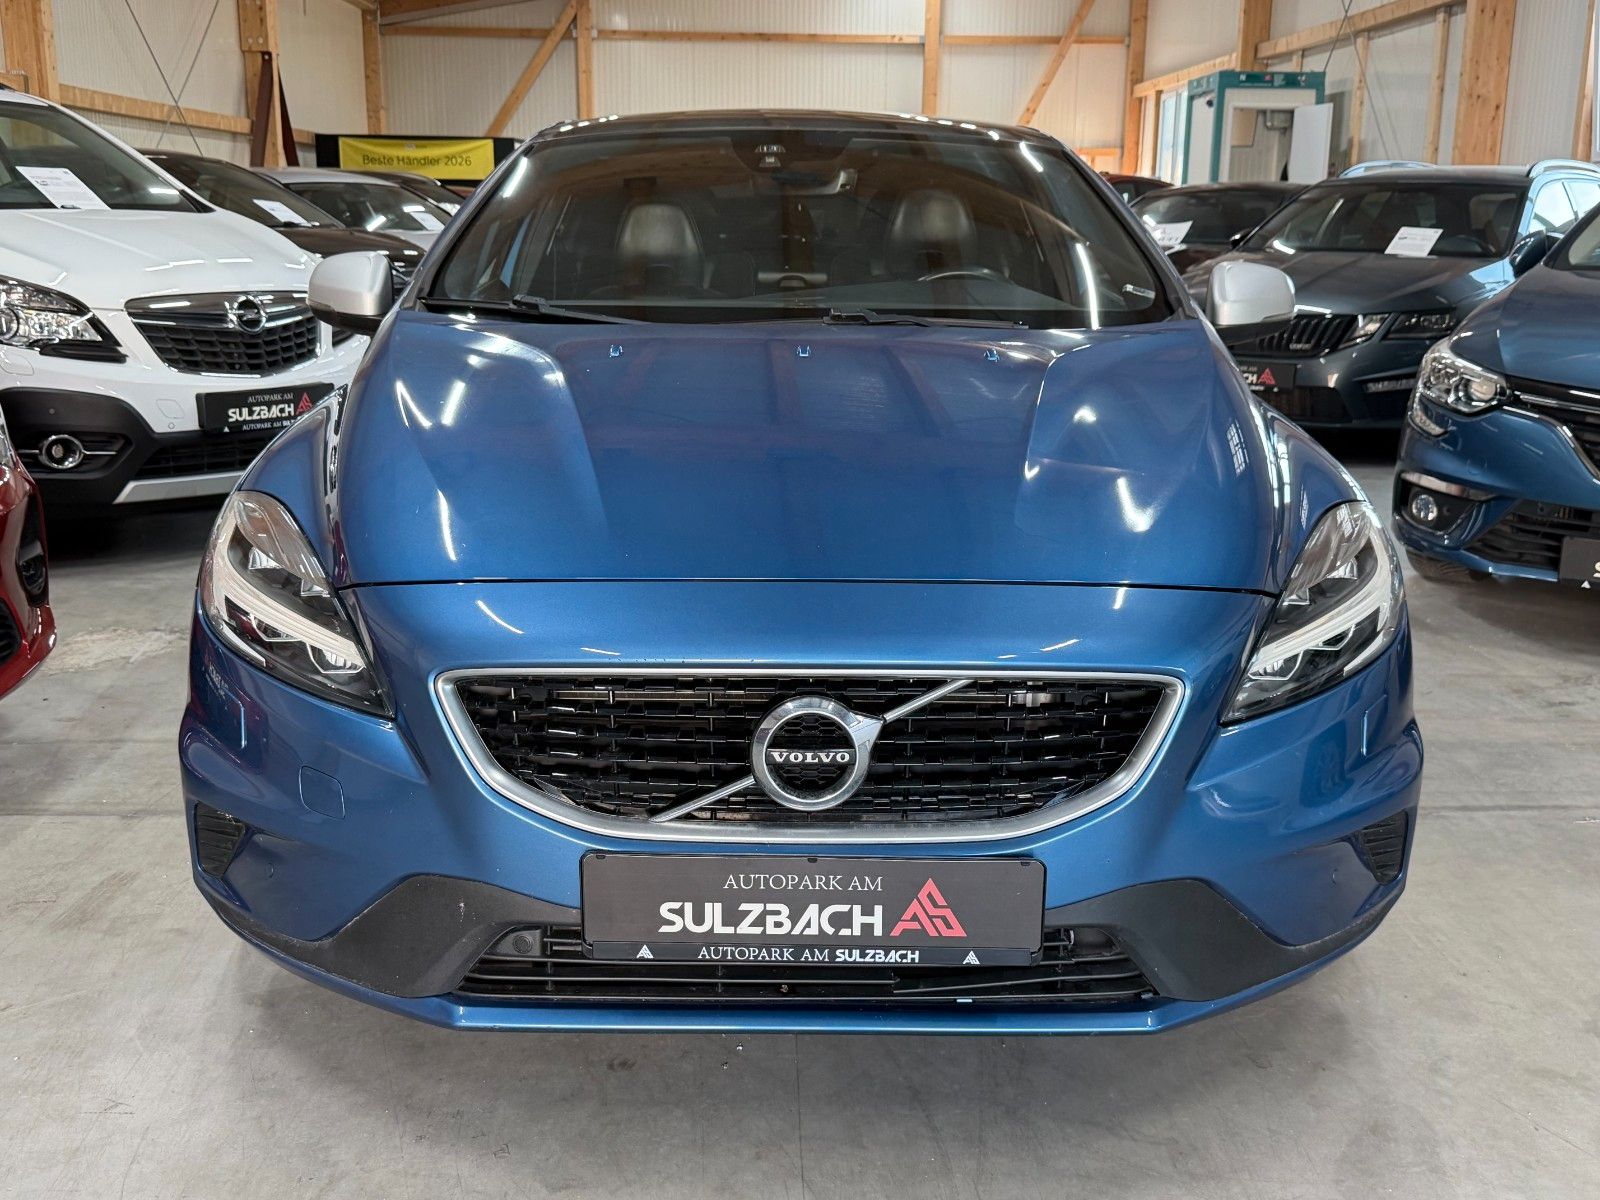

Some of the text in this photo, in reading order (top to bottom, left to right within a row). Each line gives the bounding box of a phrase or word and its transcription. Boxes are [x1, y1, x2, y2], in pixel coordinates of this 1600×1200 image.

[362, 154, 472, 167] Beste Händler 2026
[247, 392, 294, 403] AUTOPARK AM
[228, 403, 295, 422] SULZBACH
[242, 422, 272, 431] AUTOPARK
[770, 752, 850, 763] VOLVO
[723, 874, 884, 892] AUTOPARK AM
[657, 901, 883, 937] SULZBACH
[697, 946, 920, 963] AUTOPARK AM SULZBACH
